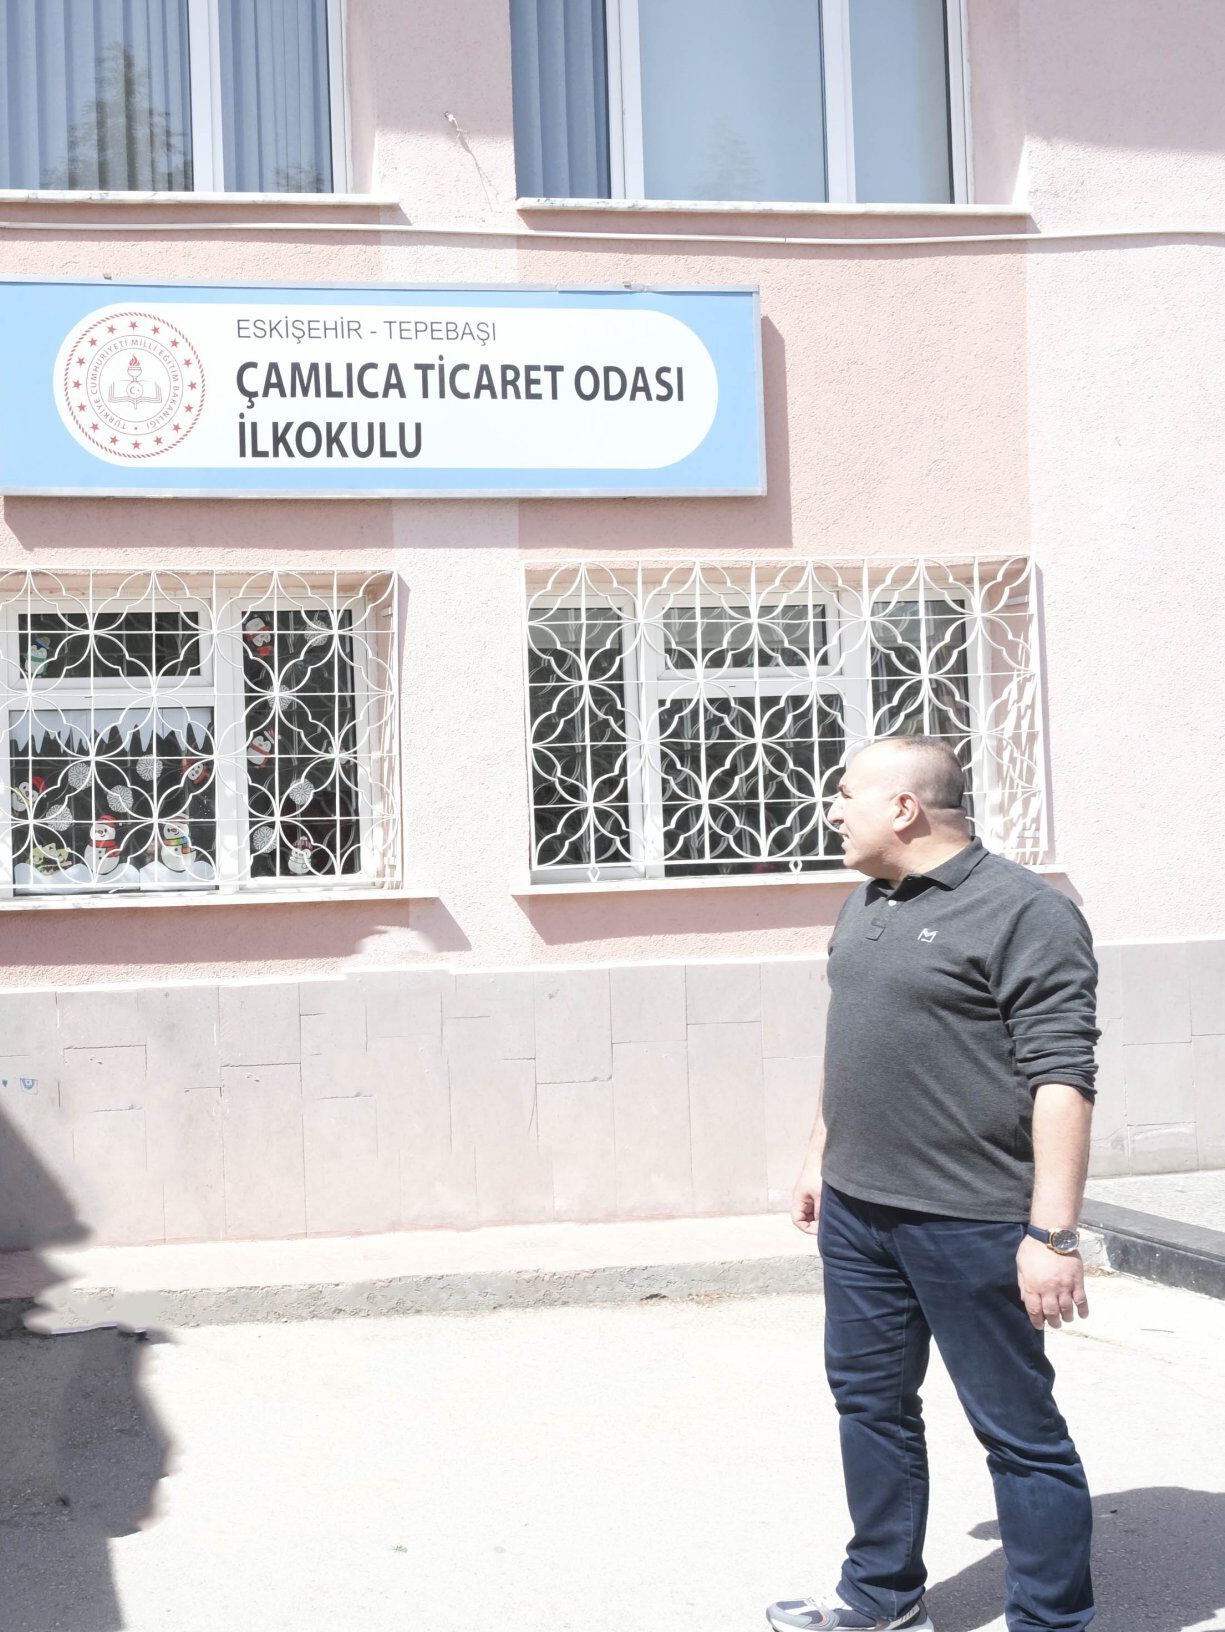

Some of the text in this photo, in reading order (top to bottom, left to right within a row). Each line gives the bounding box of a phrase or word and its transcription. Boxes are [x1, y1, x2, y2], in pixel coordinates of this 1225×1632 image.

[130, 338, 158, 351] MİLLİ
[236, 316, 363, 344] ESKİŞEHİR
[383, 320, 497, 347] TEPEBAŞI
[236, 354, 684, 409] ÇAMLICA TİCARET ODASI
[238, 412, 423, 459] İLKOKULU
